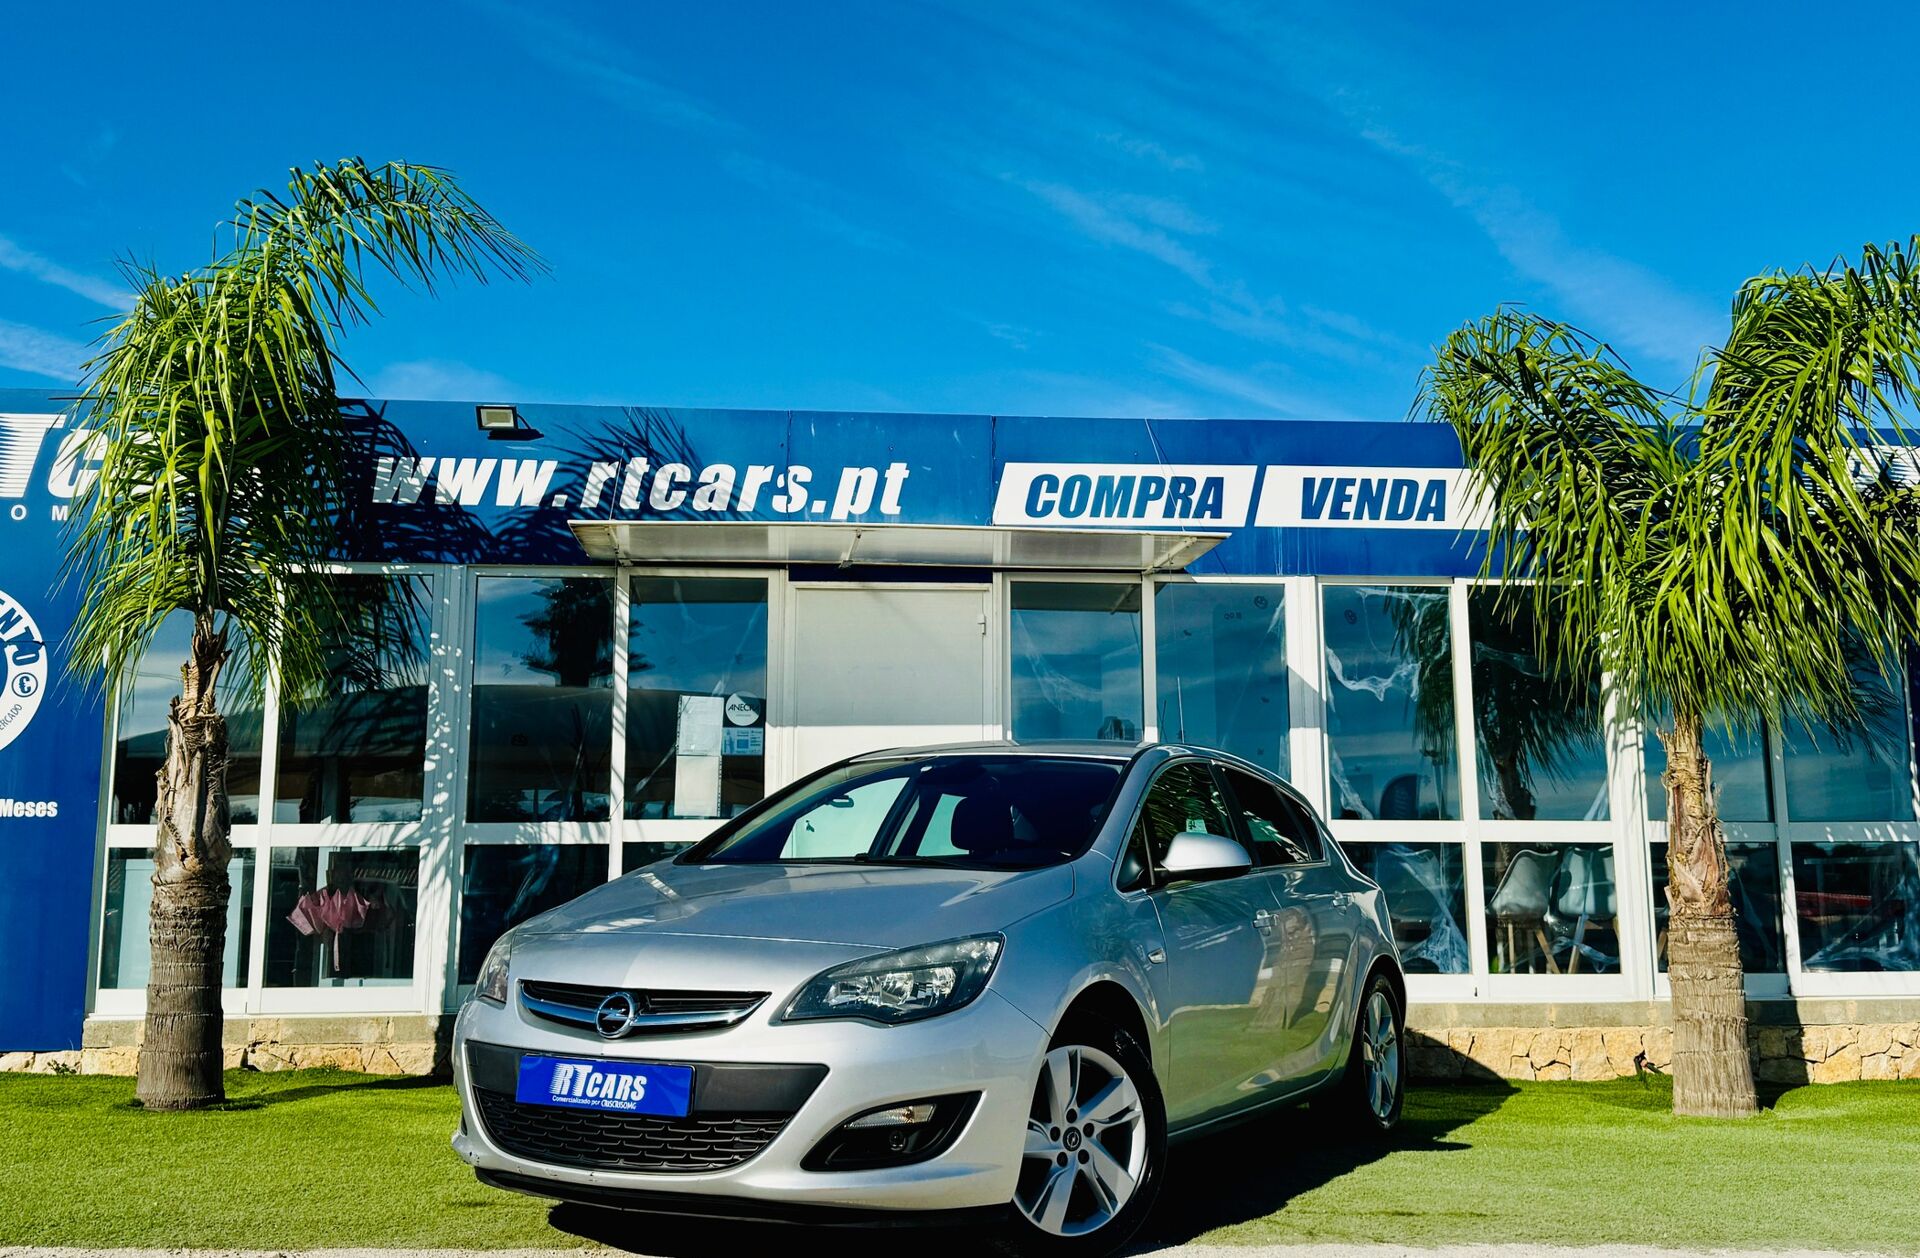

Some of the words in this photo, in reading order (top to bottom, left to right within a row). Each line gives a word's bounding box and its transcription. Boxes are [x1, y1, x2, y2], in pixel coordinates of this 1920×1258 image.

[372, 456, 911, 520] www.rtcars.pt
[1025, 473, 1225, 520] COMPRA
[1301, 476, 1447, 523] VENDA
[0, 798, 58, 818] Meses
[549, 1062, 648, 1102] RTCARS
[552, 1095, 591, 1105] Comercializado
